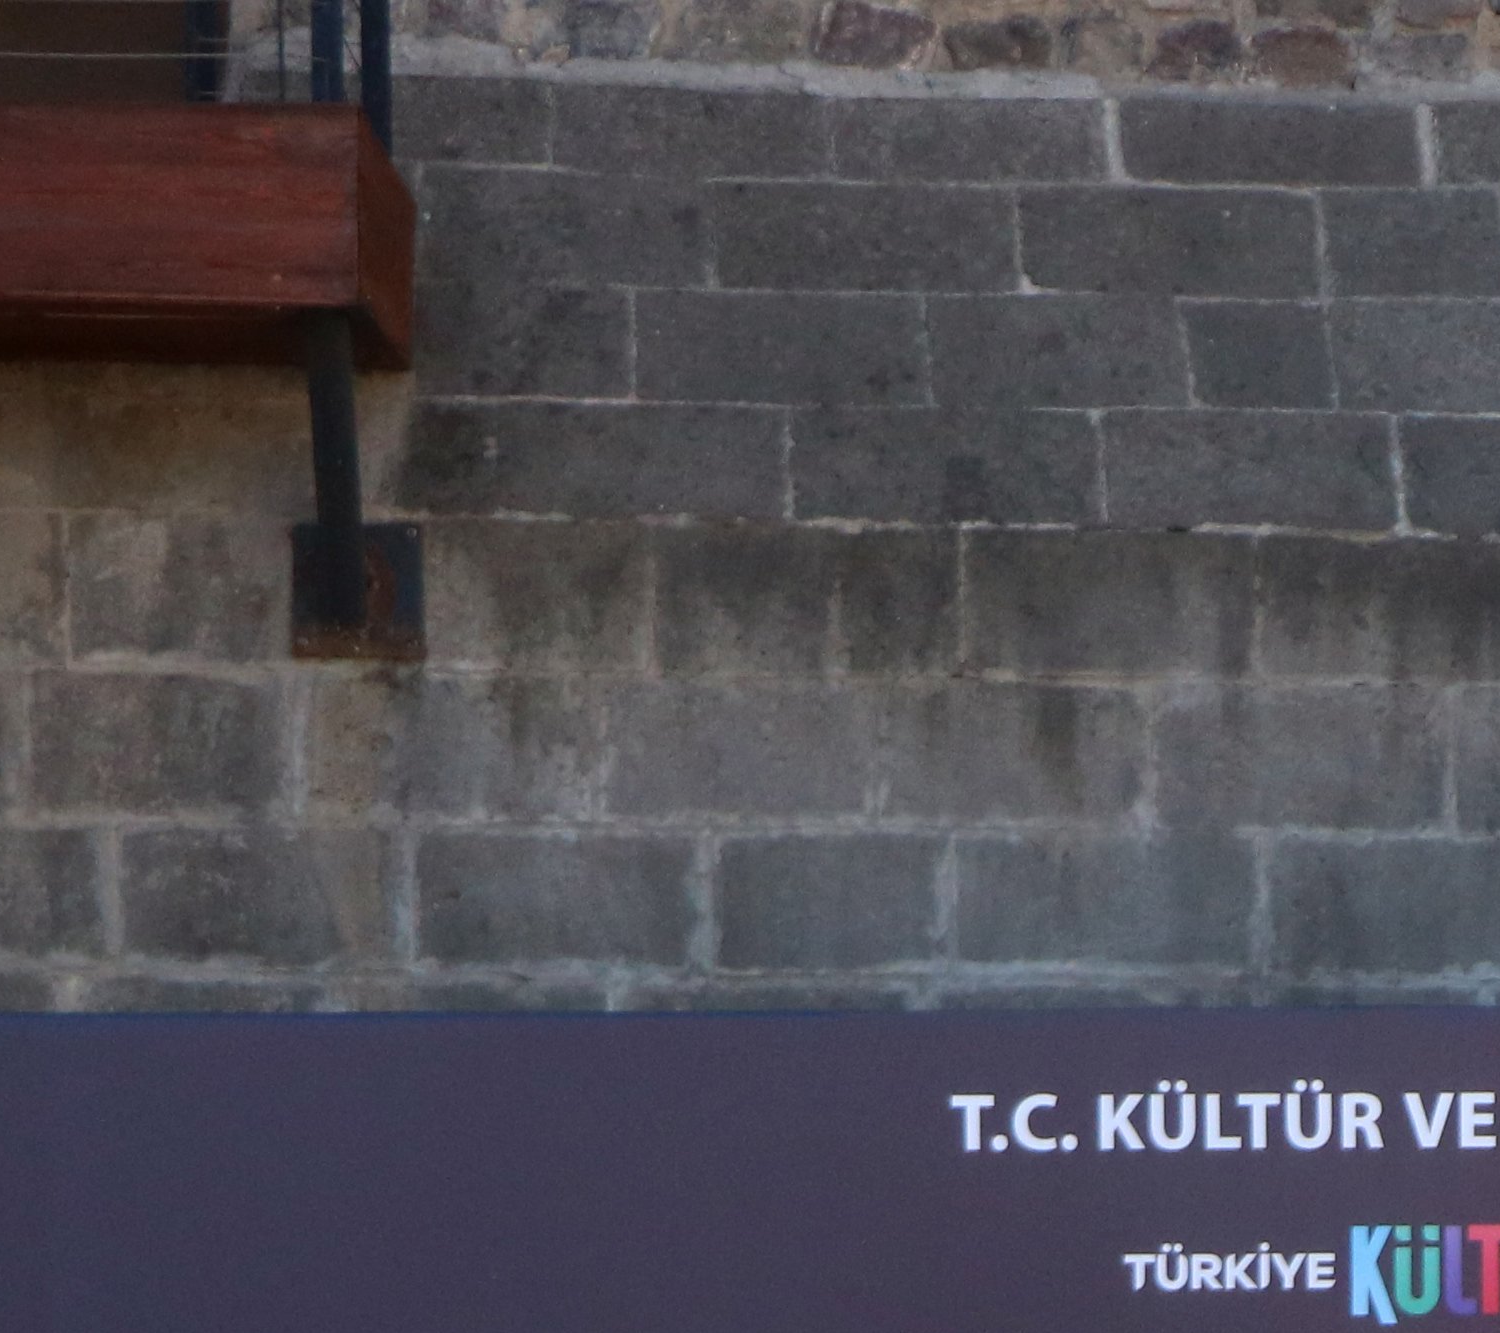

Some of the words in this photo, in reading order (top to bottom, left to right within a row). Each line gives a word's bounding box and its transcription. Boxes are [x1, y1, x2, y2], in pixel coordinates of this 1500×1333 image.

[952, 1092, 1077, 1153] T.C.
[1097, 1082, 1381, 1152] KÜLTÜR
[1407, 1092, 1497, 1152] VE
[1124, 1240, 1336, 1292] TÜRKİYE
